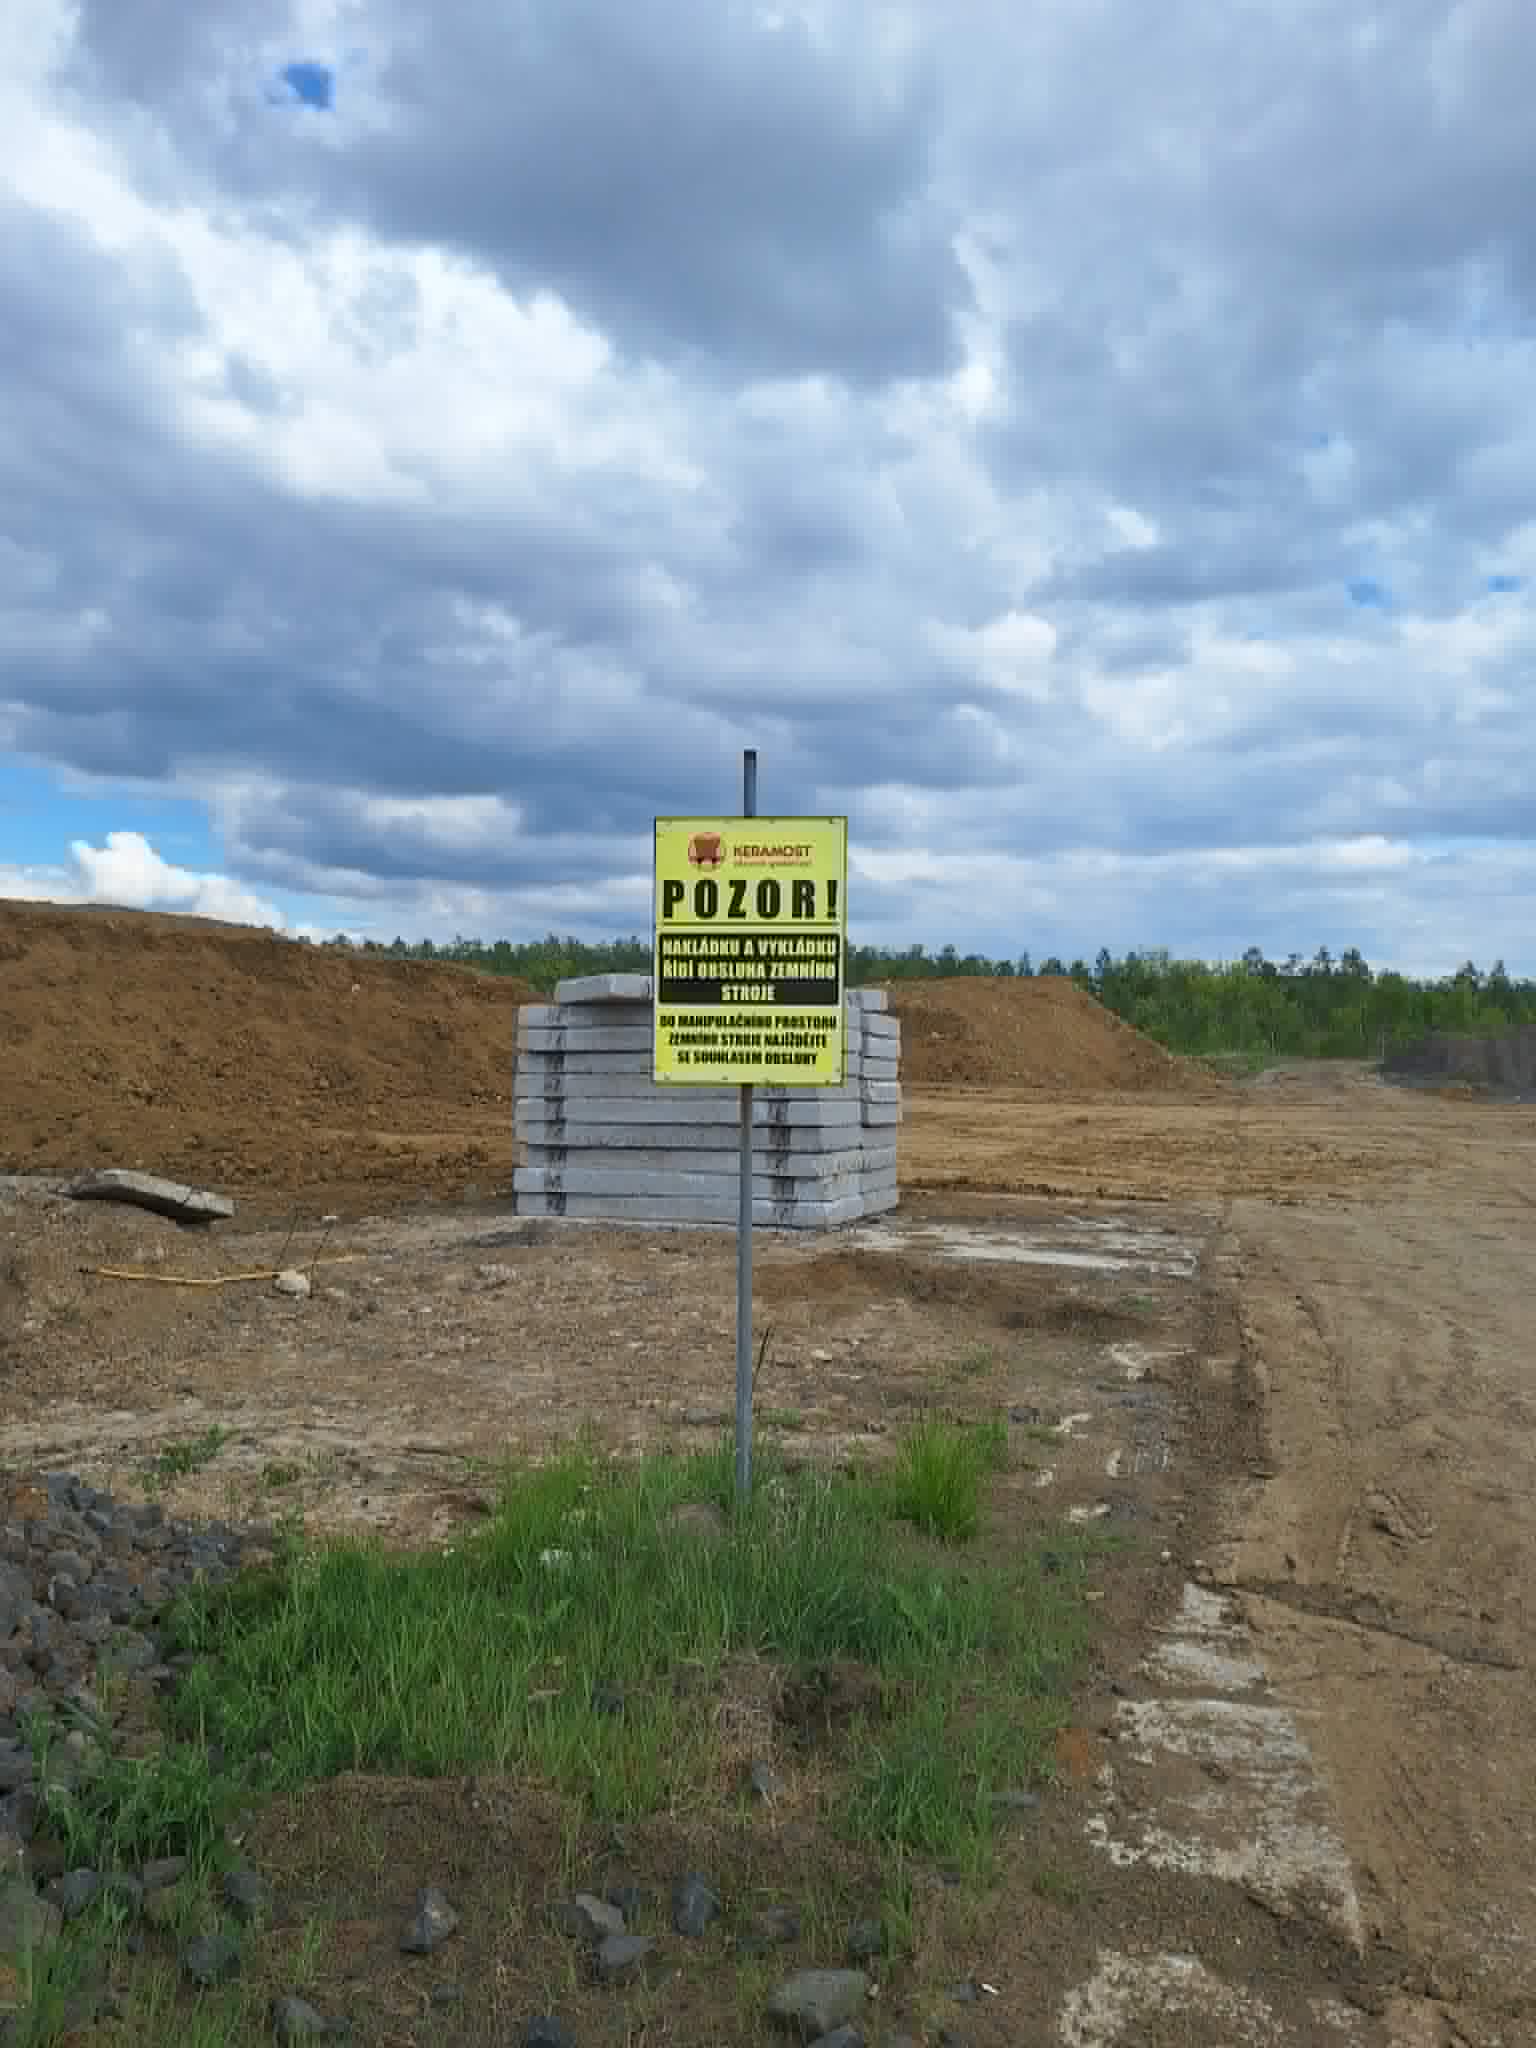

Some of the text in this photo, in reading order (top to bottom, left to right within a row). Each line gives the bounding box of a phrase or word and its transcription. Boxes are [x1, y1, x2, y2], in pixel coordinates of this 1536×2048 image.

[663, 879, 838, 919] POZOR!
[744, 937, 753, 956] A
[721, 984, 777, 1001] STROJE
